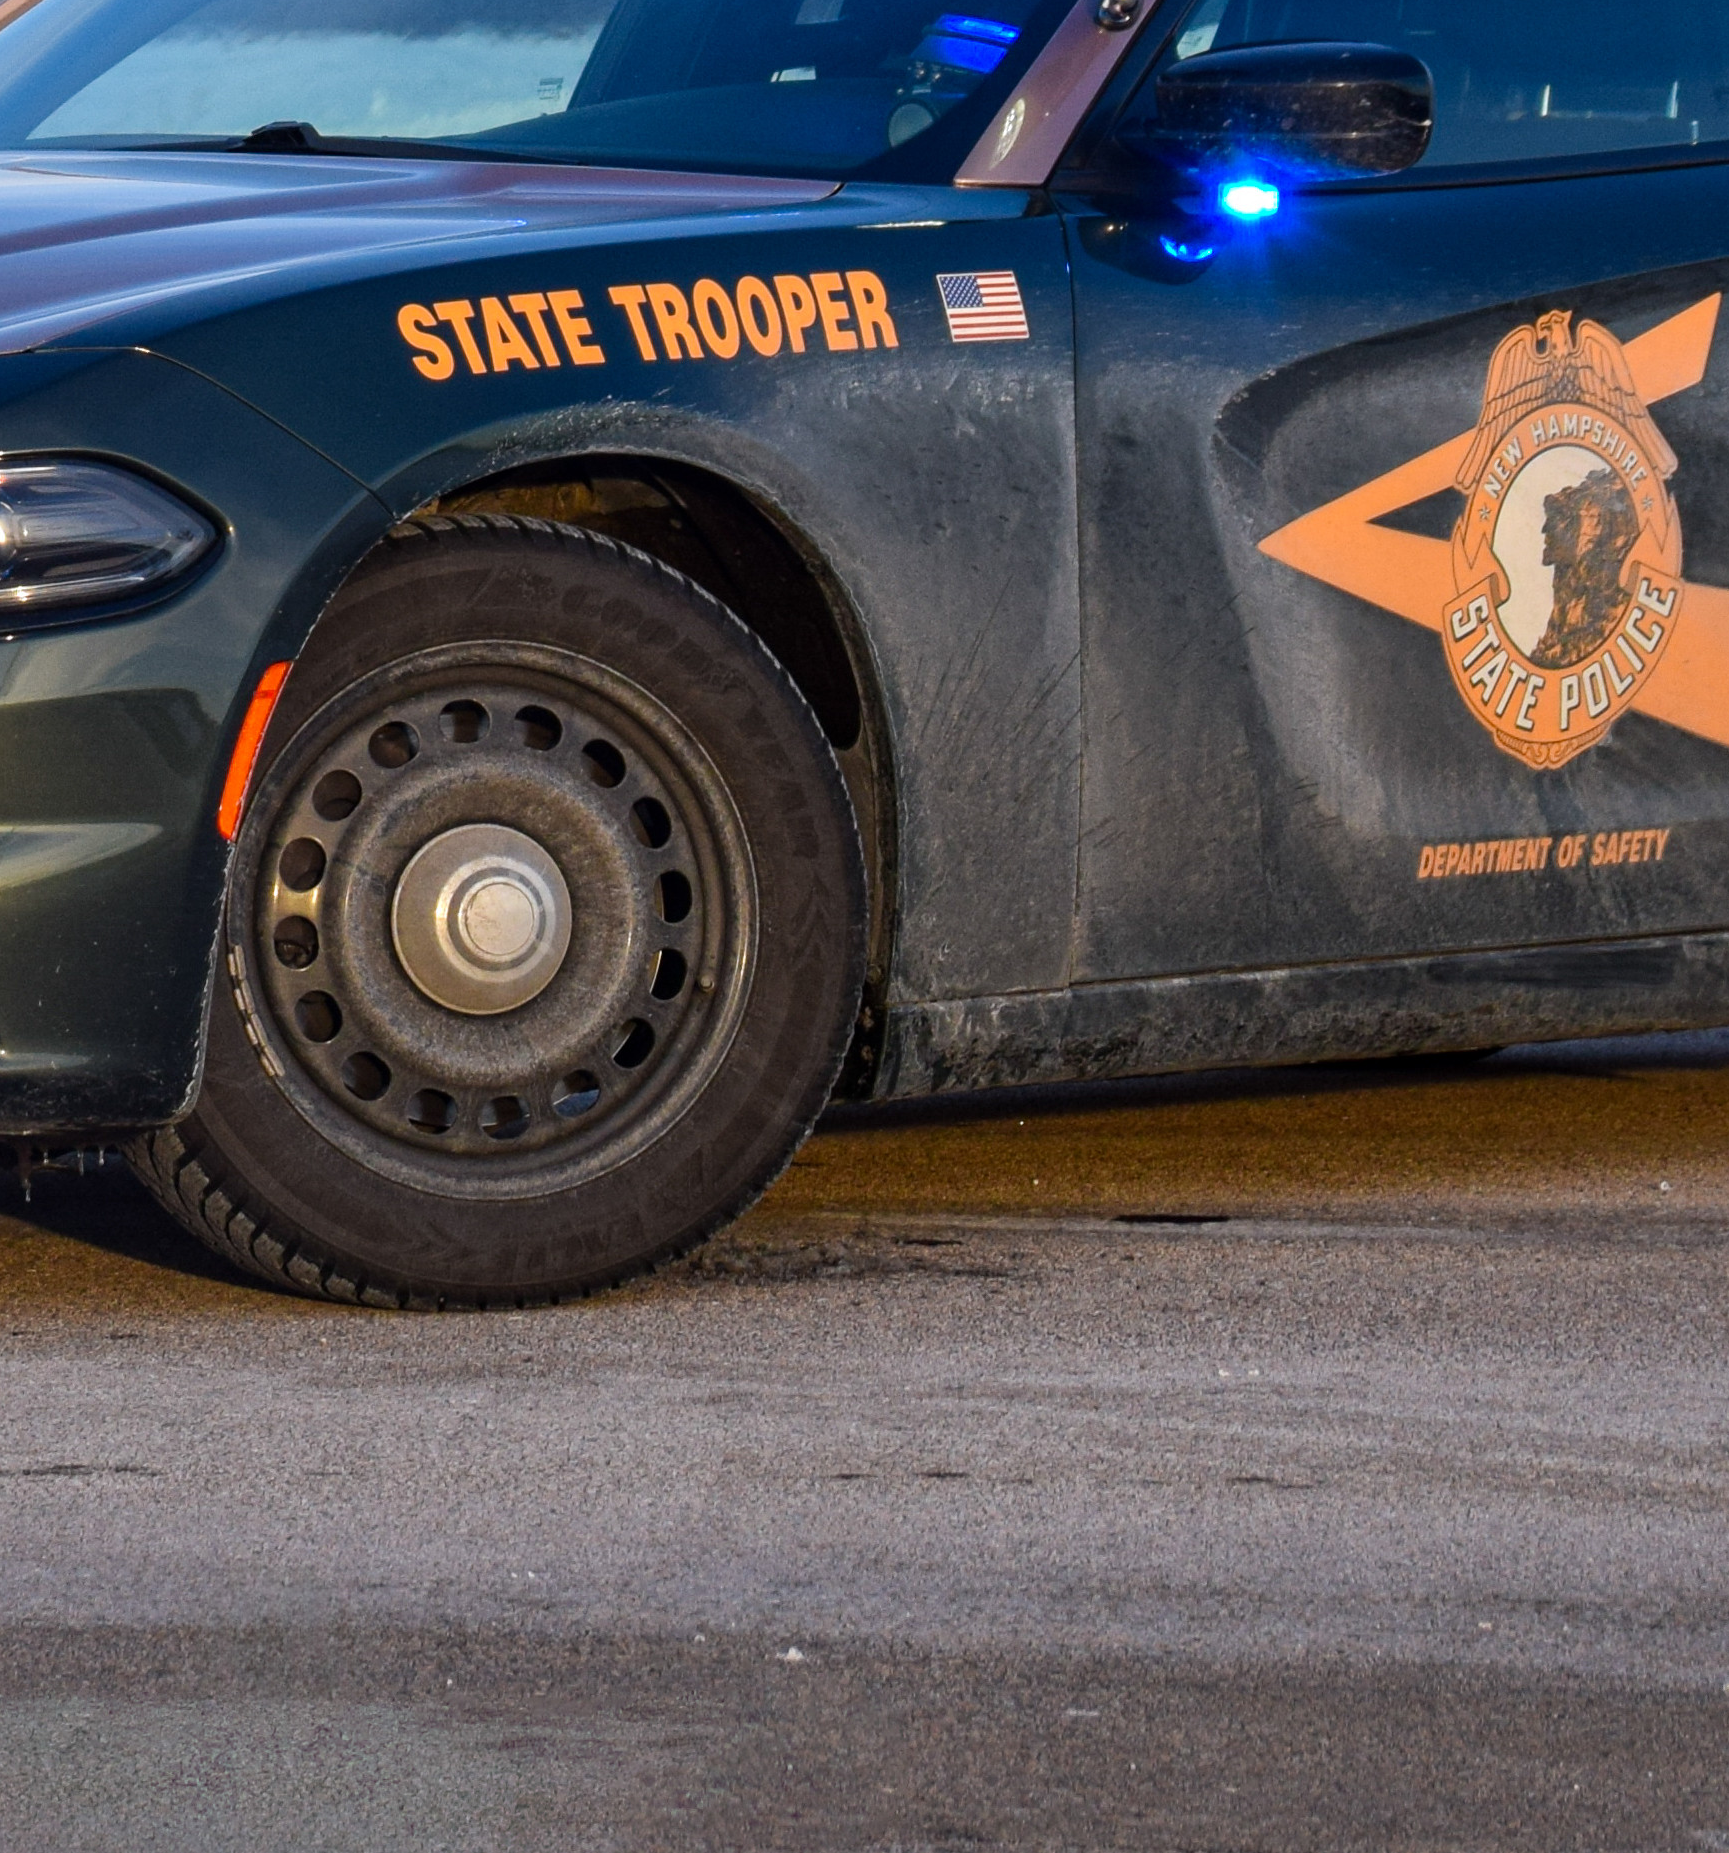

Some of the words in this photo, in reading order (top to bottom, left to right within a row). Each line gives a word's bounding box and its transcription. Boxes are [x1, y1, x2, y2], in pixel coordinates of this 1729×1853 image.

[397, 289, 606, 381] STATE
[608, 270, 899, 360] TROOPER
[1484, 437, 1524, 500] NEW
[1530, 413, 1648, 491] HAMPSHIRE
[1451, 594, 1546, 730] STATE
[1560, 578, 1676, 730] POLICE
[1418, 837, 1553, 879] DEPARTMENT
[1556, 834, 1588, 868] OF
[1591, 829, 1670, 866] SAFETY
